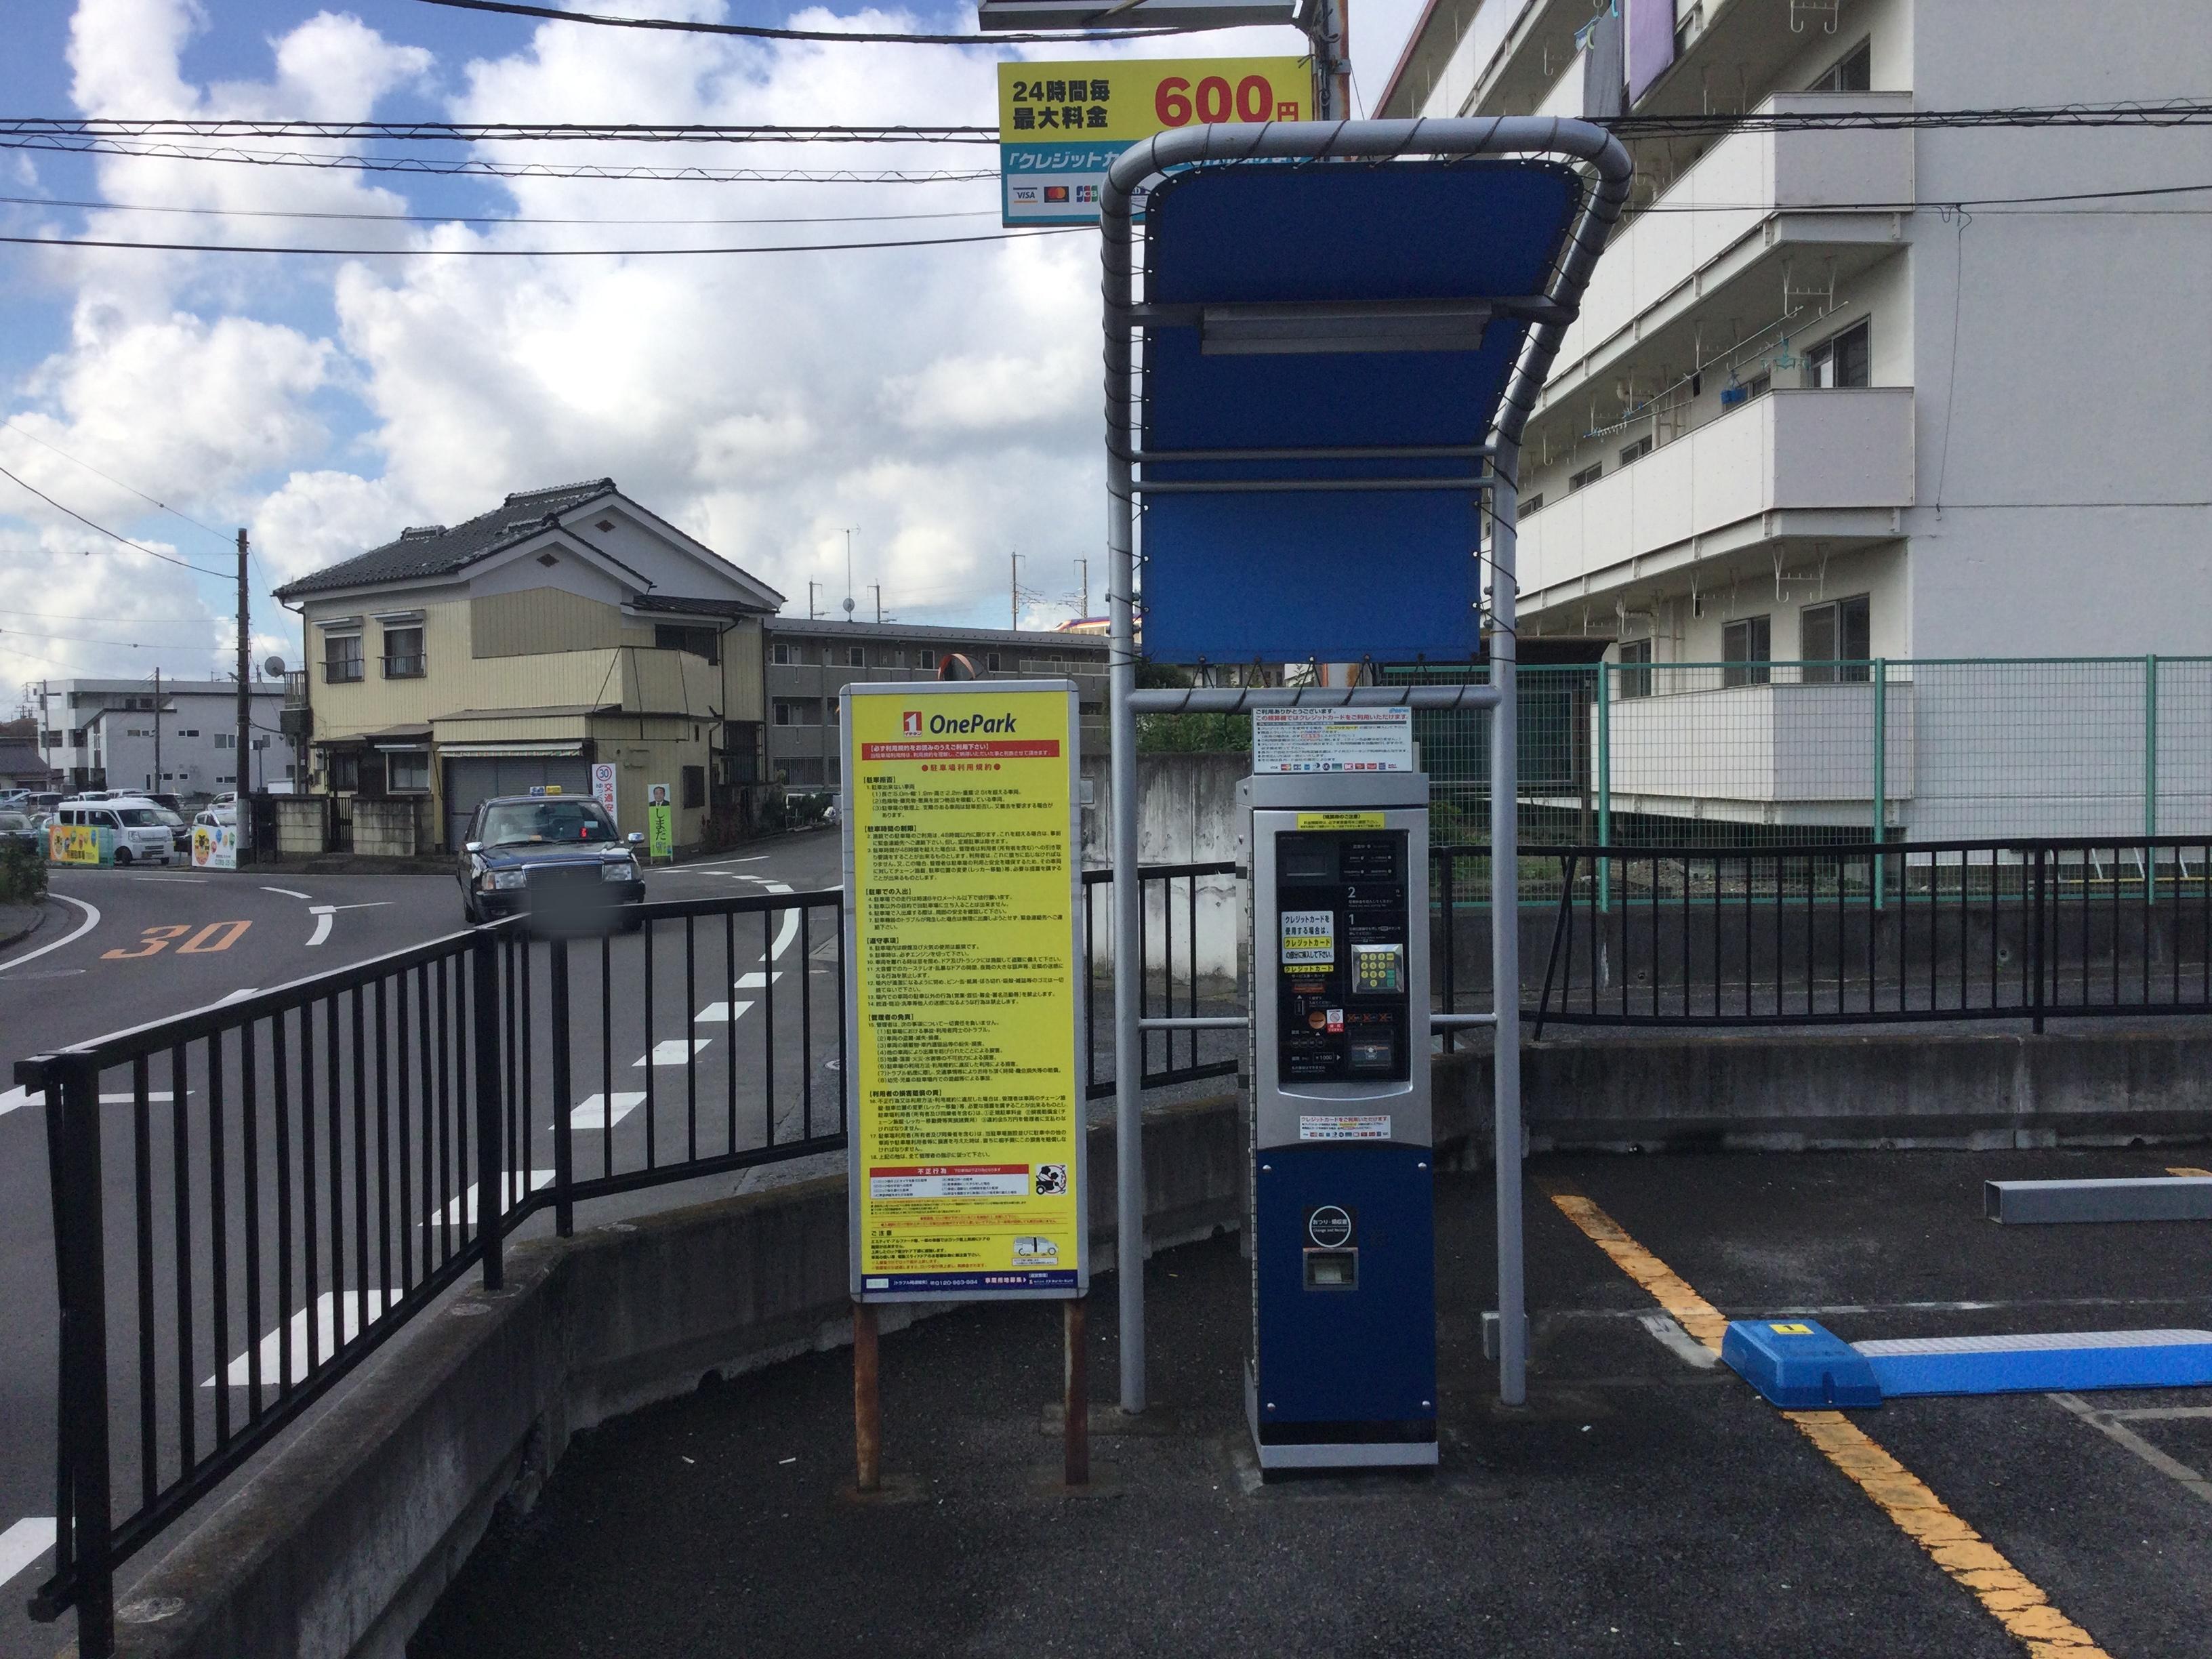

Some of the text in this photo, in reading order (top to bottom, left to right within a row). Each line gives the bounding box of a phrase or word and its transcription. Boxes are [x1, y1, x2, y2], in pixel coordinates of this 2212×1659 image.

[1012, 79, 1110, 102] 24時間毎
[1013, 106, 1109, 129] 最大料金
[1076, 188, 1099, 200] JCB
[930, 713, 1017, 734] OnePark
[599, 769, 609, 778] 30
[604, 783, 614, 817] 交通安
[655, 808, 666, 841] しまだ
[1348, 886, 1356, 898] 2
[1285, 916, 1330, 924] クレジットカードを
[1349, 914, 1354, 925] 1
[100, 920, 253, 960] 30
[1285, 939, 1330, 947] クレジットカード
